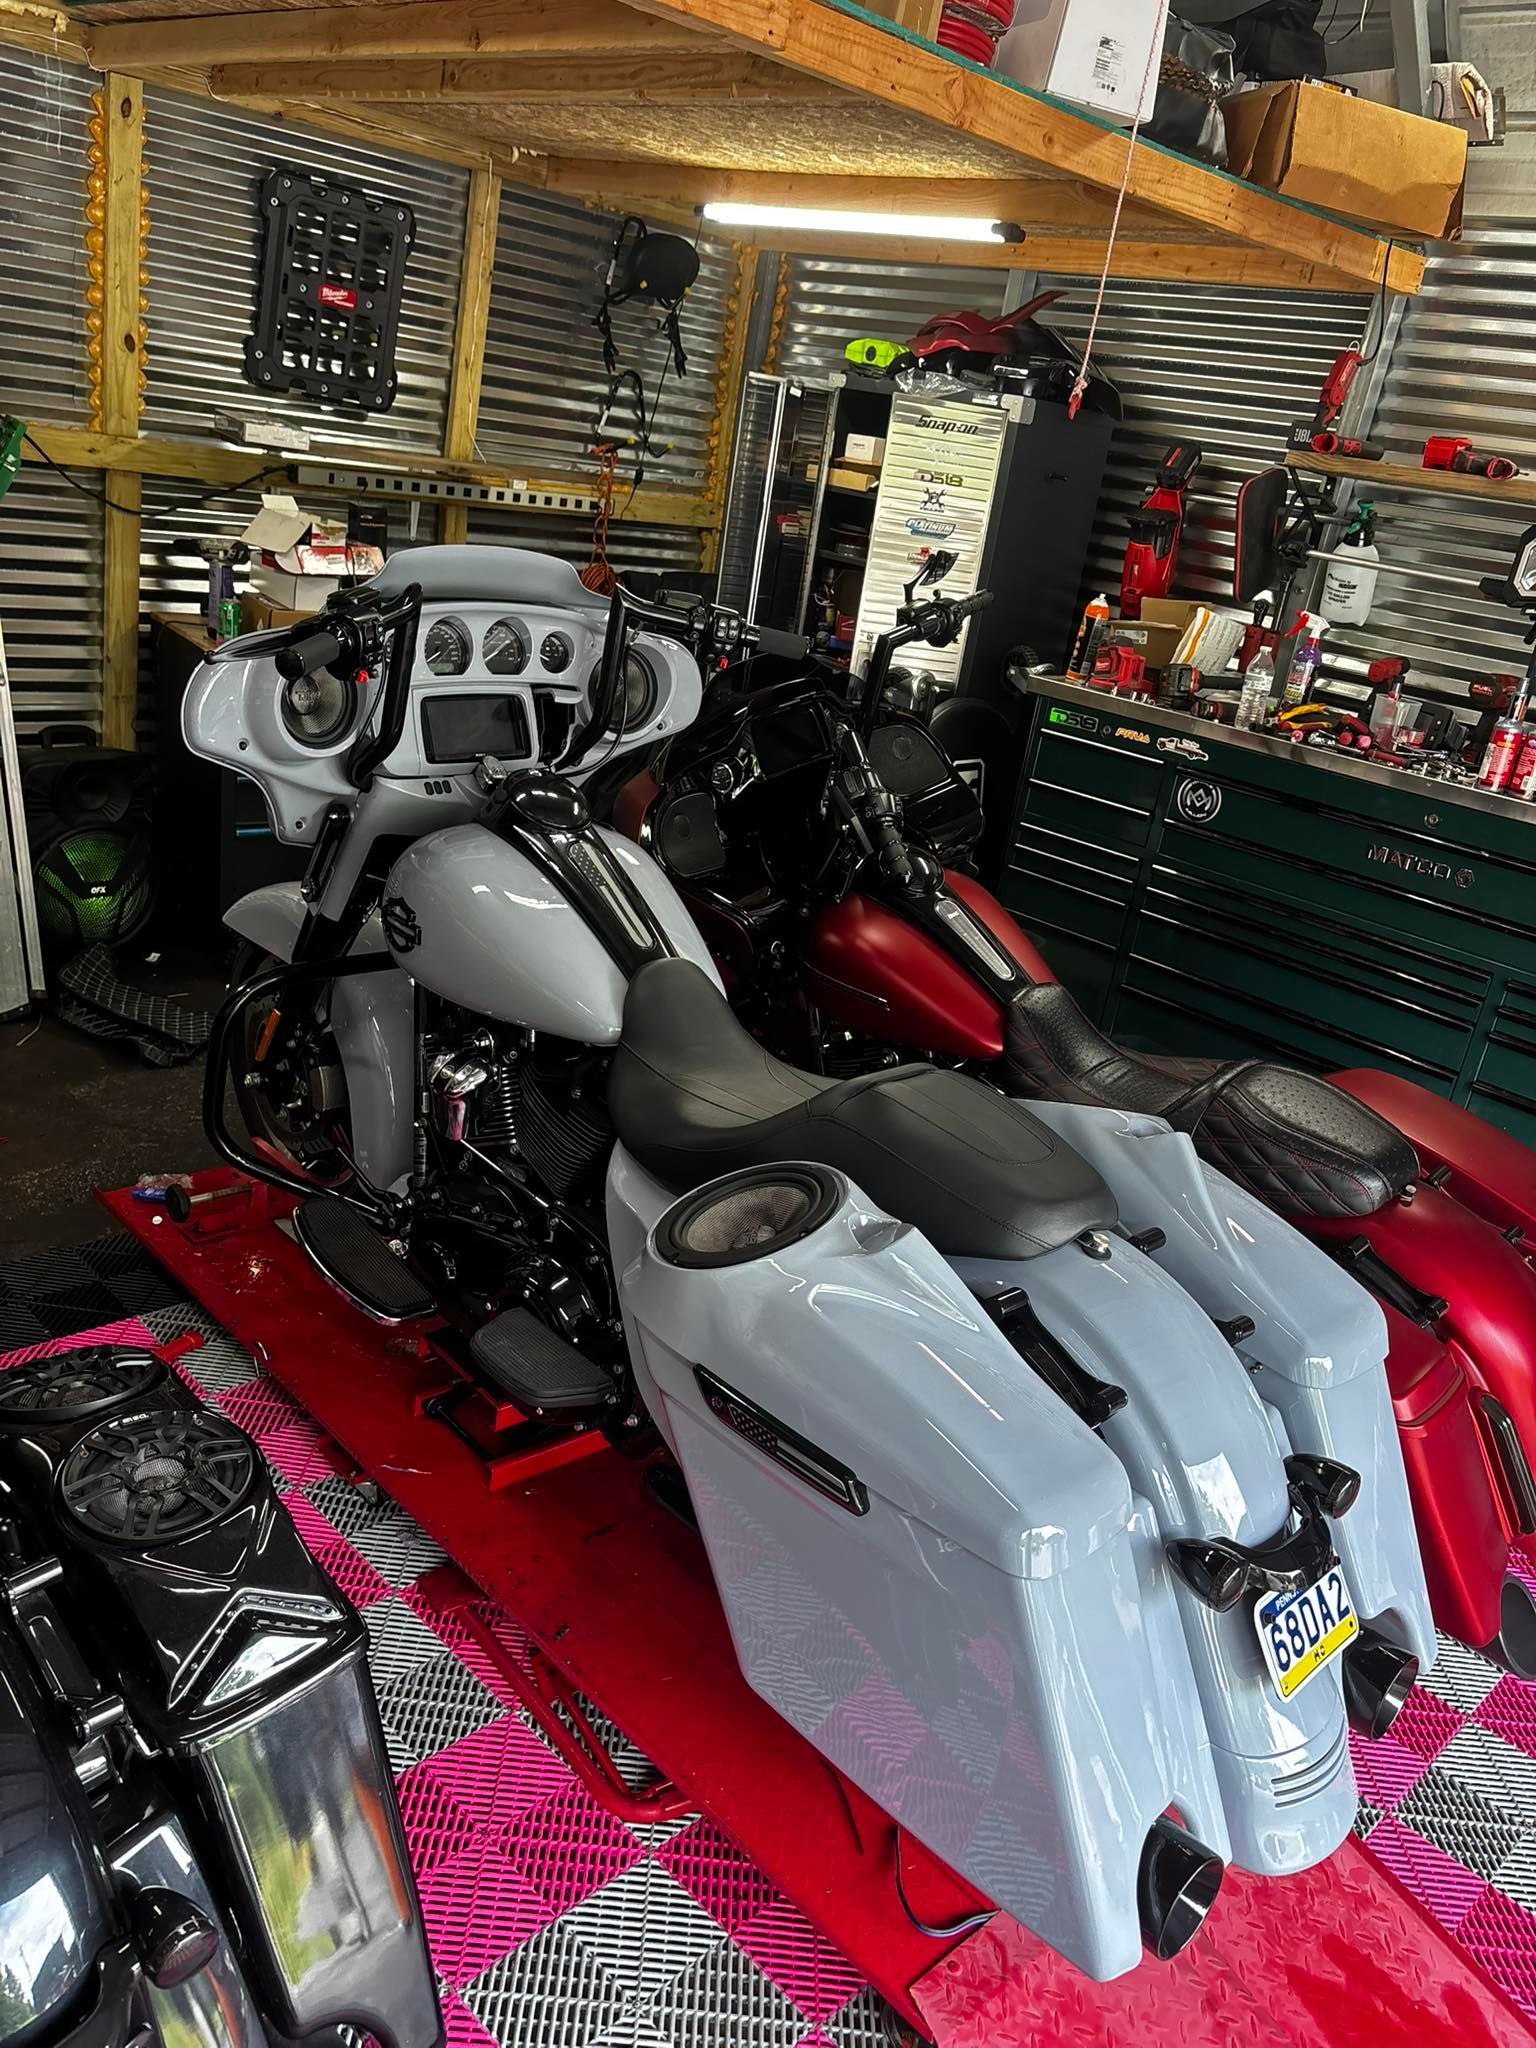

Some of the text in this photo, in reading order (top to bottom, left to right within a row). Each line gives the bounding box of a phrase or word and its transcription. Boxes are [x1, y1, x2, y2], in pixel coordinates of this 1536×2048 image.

[915, 414, 979, 435] Snap-on
[1294, 427, 1313, 443] JBL
[906, 519, 956, 534] PLATINUM
[1472, 684, 1493, 692] FUEL
[1050, 707, 1099, 732] DS18
[1367, 843, 1451, 880] MATCO
[1270, 1573, 1350, 1673] 68DA2
